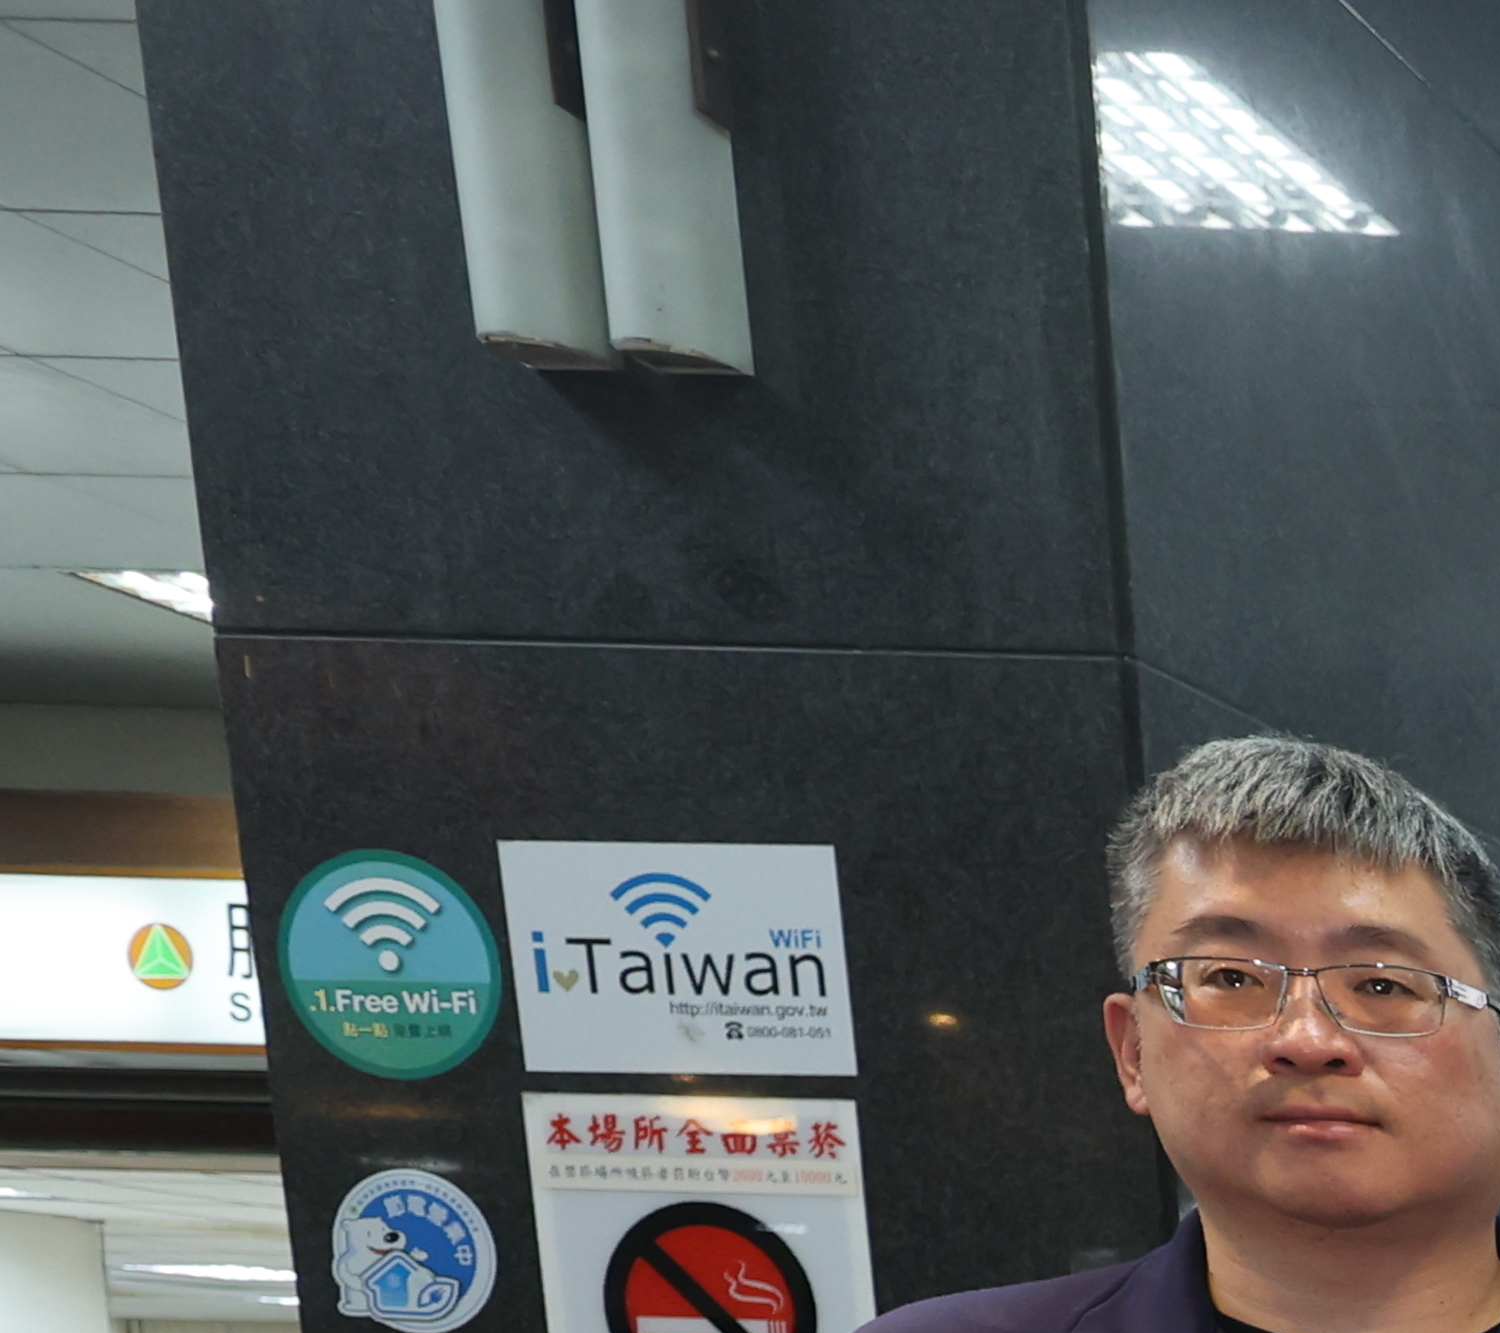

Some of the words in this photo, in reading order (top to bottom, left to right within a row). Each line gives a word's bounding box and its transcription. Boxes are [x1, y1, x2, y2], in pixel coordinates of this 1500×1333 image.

[769, 929, 822, 949] WiFi
[401, 988, 477, 1015] Wi-Fi
[669, 1001, 828, 1021] http://itaiwan.gov.tw
